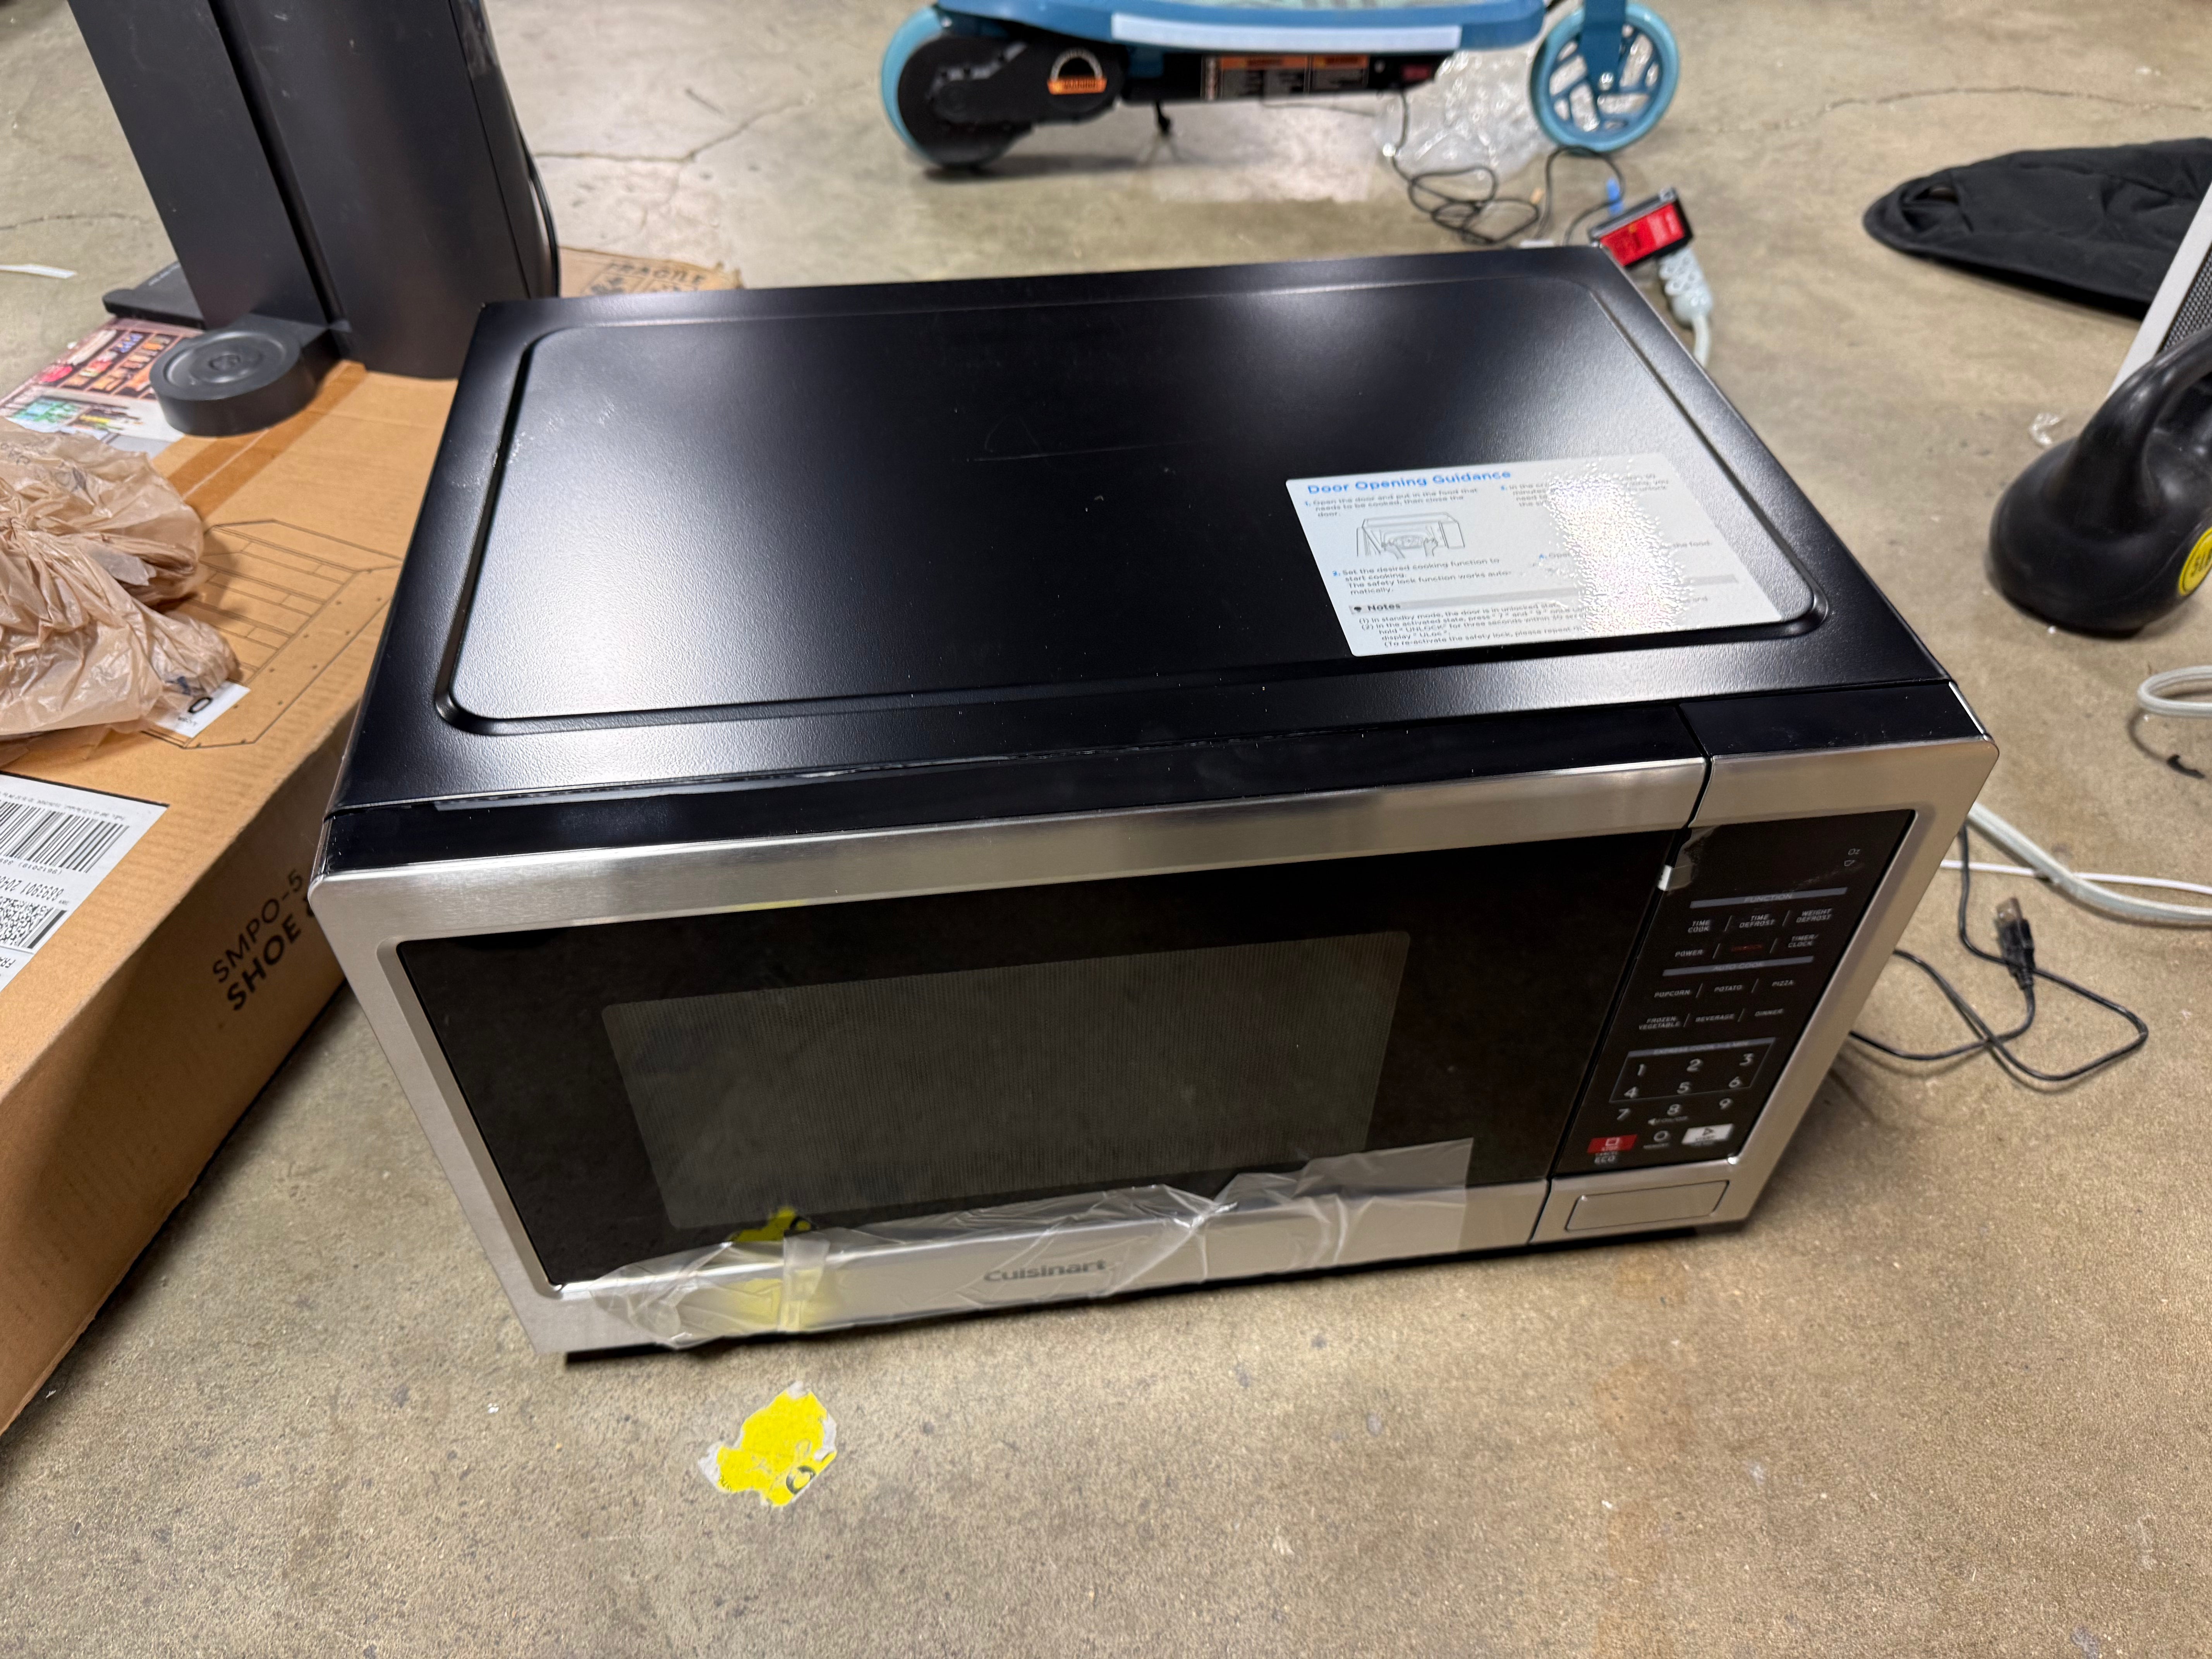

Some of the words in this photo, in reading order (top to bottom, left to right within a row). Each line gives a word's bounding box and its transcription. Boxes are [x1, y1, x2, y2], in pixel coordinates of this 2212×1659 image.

[1307, 484, 1349, 494] Door
[1355, 477, 1427, 490] Opening
[1433, 471, 1511, 484] Guidance
[1377, 565, 1410, 573] desired
[1412, 562, 1448, 570] cooking
[1451, 559, 1487, 567] function
[1419, 575, 1456, 583] function
[1367, 603, 1401, 611] Notes
[20, 882, 64, 902] 8893901
[1743, 893, 1793, 903] FUNCTION
[1796, 914, 1832, 923] DEFROST
[1801, 908, 1832, 917] WEIGHT
[213, 869, 303, 983] SMPO-5
[1739, 919, 1776, 928] DEFROST
[227, 914, 302, 1012] SHOE
[1654, 989, 1692, 998] POPCORN
[1714, 984, 1743, 993] POTATO
[1695, 1013, 1735, 1022] BEVERAGE
[1754, 1008, 1784, 1017] DINNER
[1639, 1021, 1681, 1030] VEGETABLE
[1686, 1058, 1703, 1072] 2
[1739, 1053, 1754, 1066] 3
[1637, 1063, 1646, 1077] 1
[1677, 1081, 1691, 1094] 5
[1729, 1076, 1742, 1089] 6
[1624, 1086, 1638, 1099] 4
[1667, 1104, 1681, 1116] 8
[1719, 1098, 1733, 1110] 9
[1617, 1108, 1631, 1121] 7
[1653, 1130, 1670, 1142] 0
[984, 1259, 1106, 1281] Cuisinart
